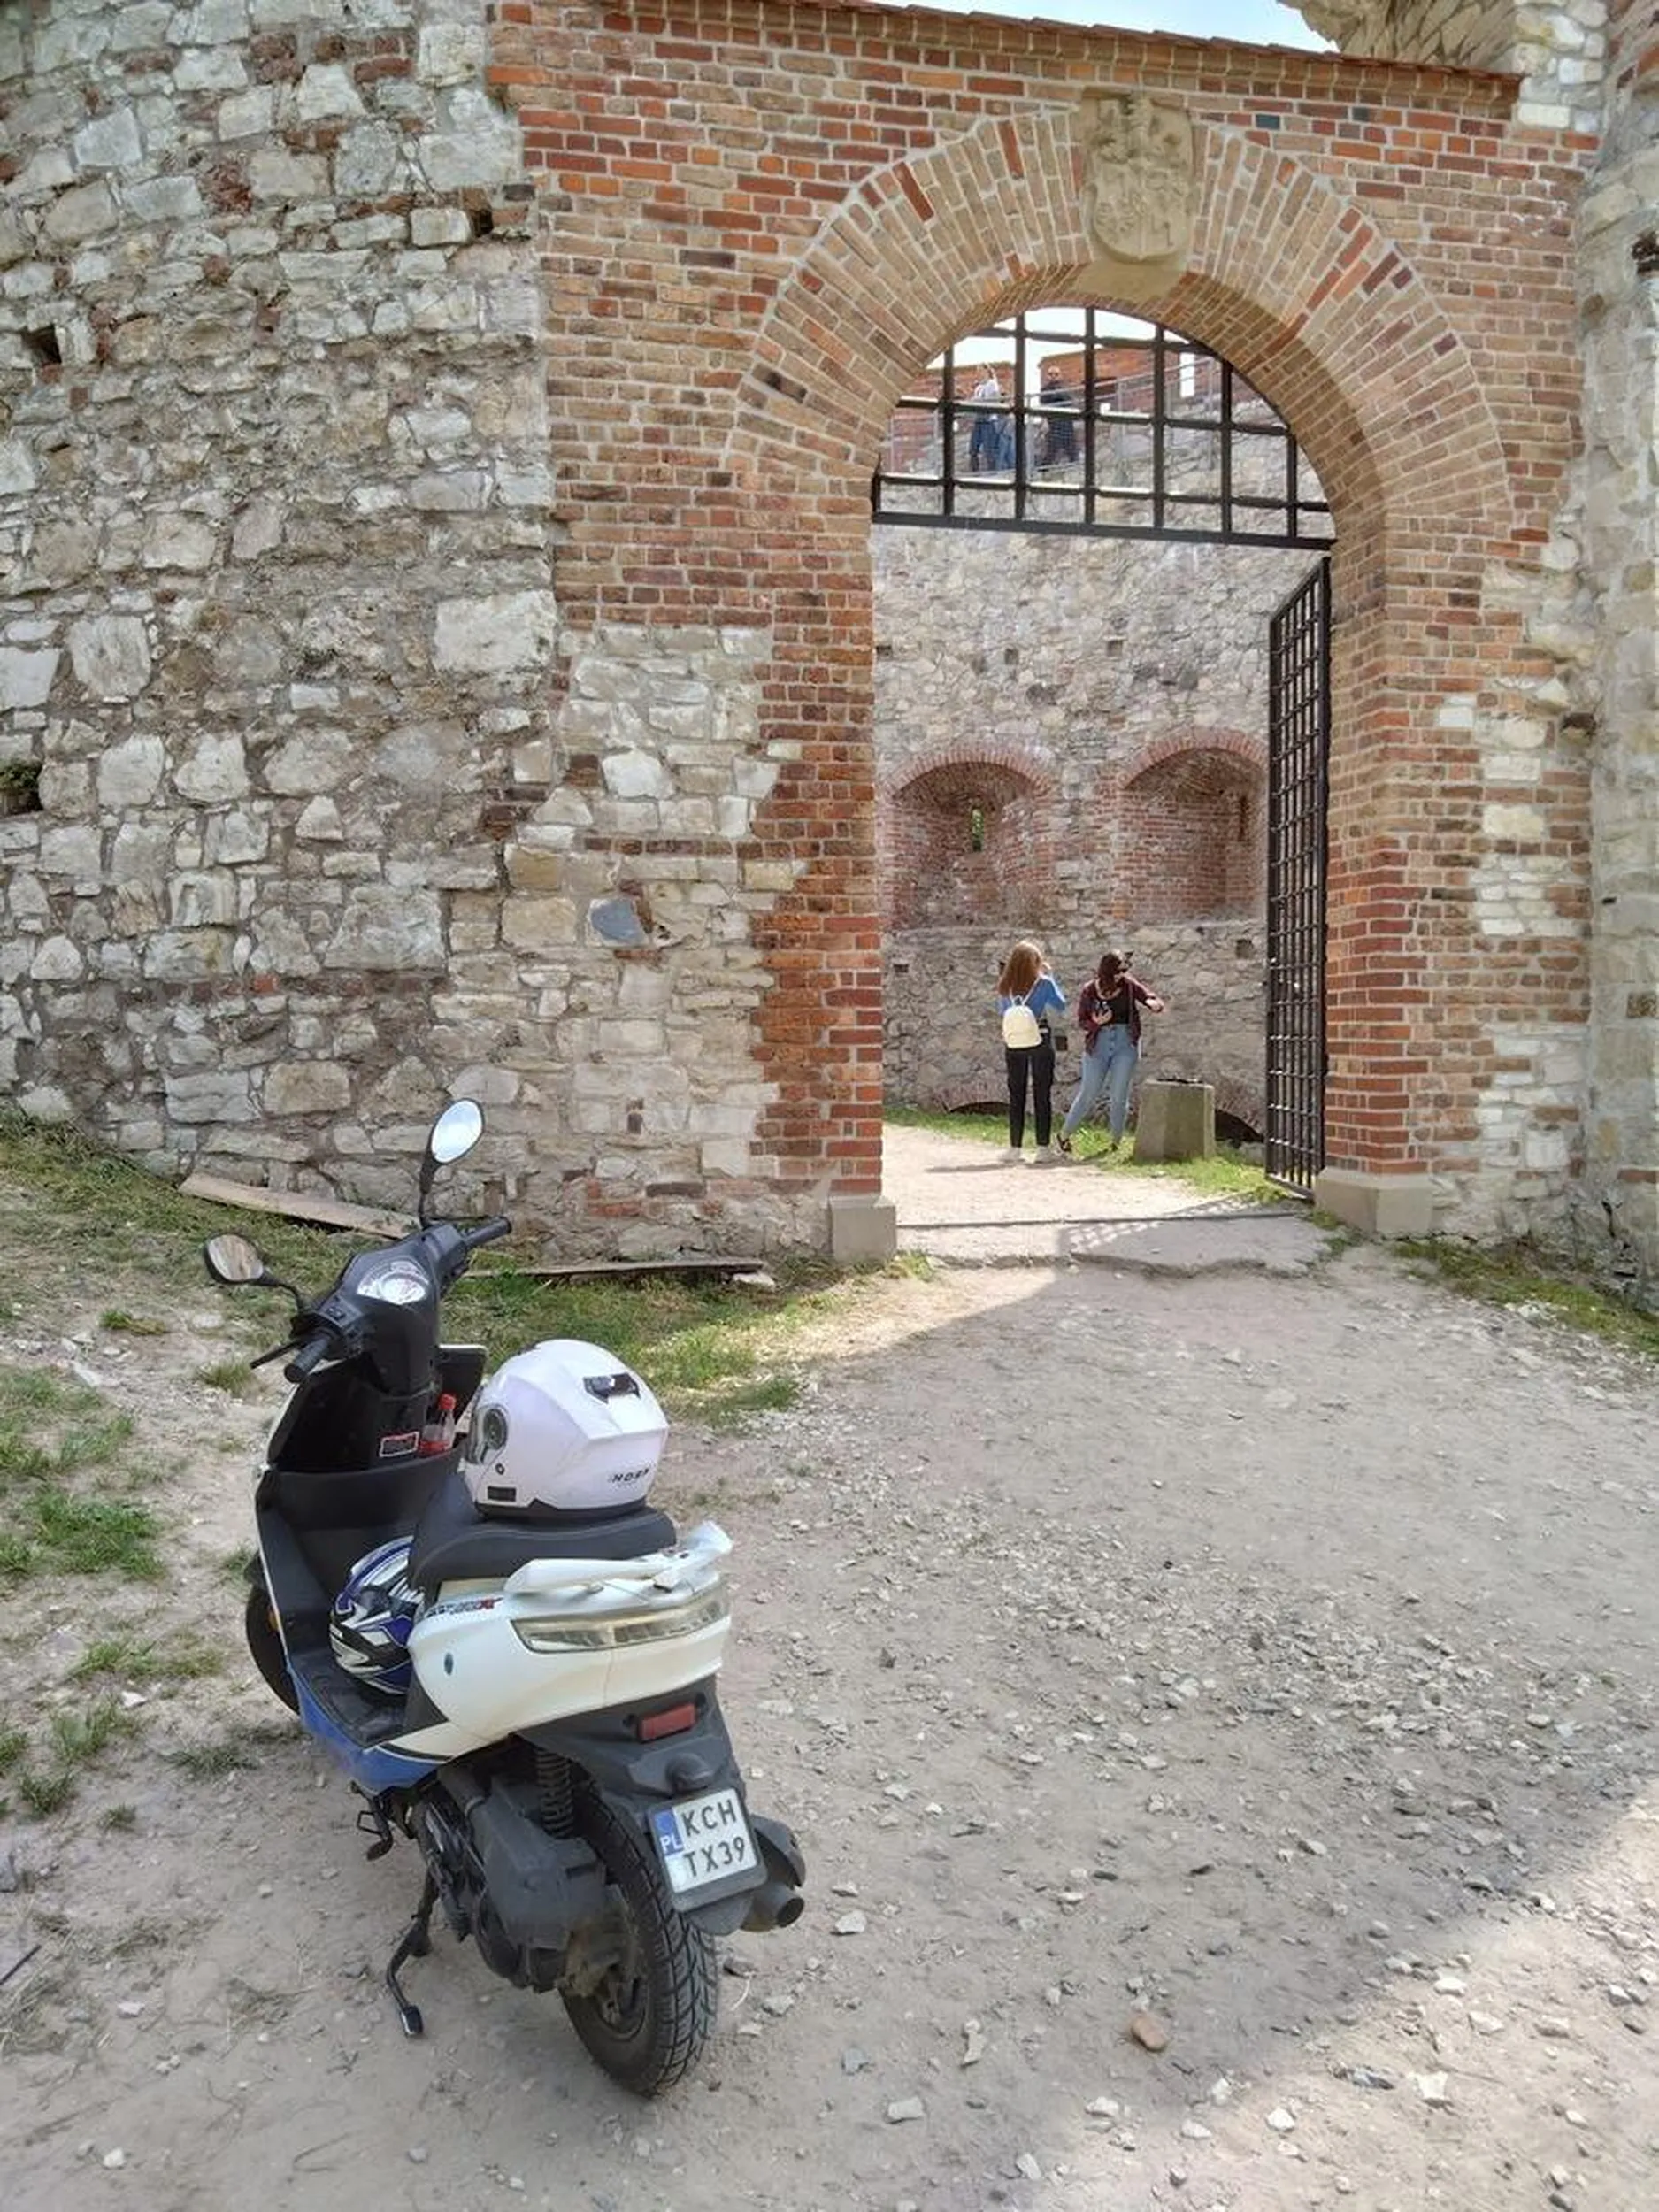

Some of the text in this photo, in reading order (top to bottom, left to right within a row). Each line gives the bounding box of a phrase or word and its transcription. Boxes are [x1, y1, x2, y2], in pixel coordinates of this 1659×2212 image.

[681, 1799, 737, 1838] KCH
[660, 1833, 684, 1852] PL
[682, 1836, 745, 1877] TX39
